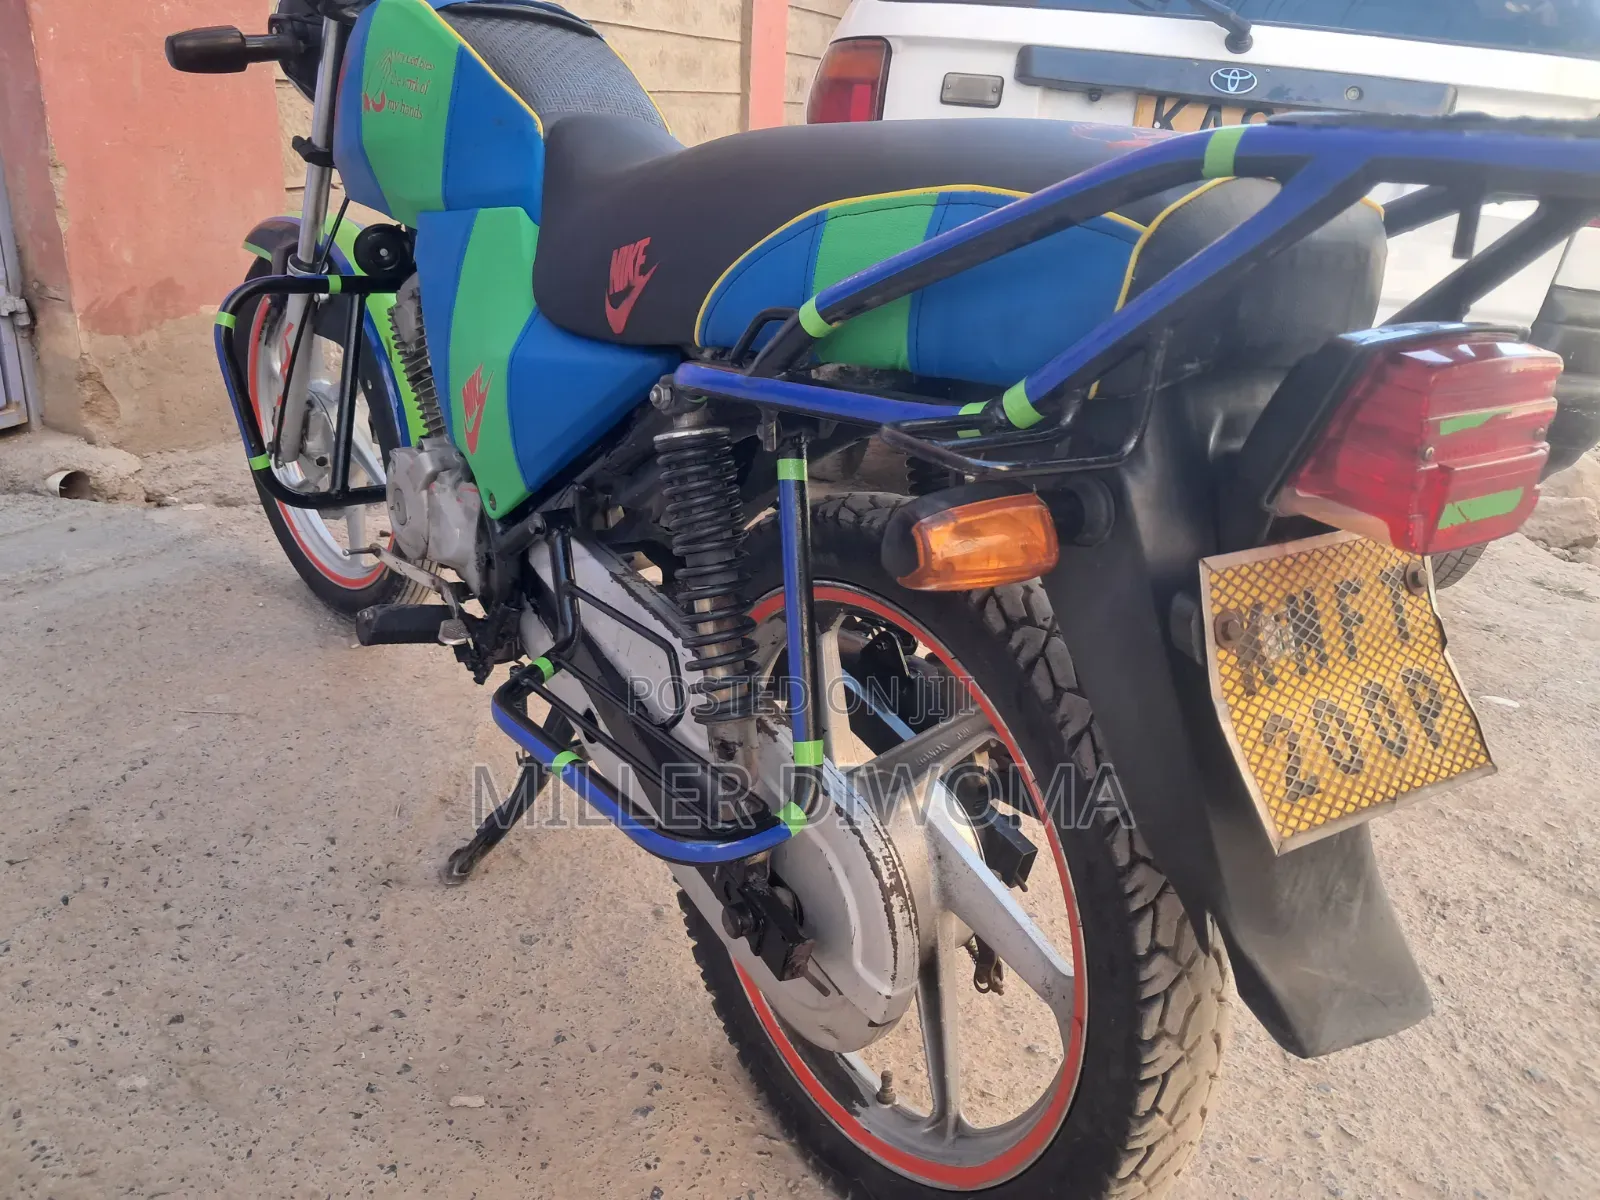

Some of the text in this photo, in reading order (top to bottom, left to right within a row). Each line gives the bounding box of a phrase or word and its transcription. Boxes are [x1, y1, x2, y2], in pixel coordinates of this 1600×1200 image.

[387, 99, 424, 120] my hands
[608, 236, 652, 296] NIKE
[461, 361, 484, 425] NIKE
